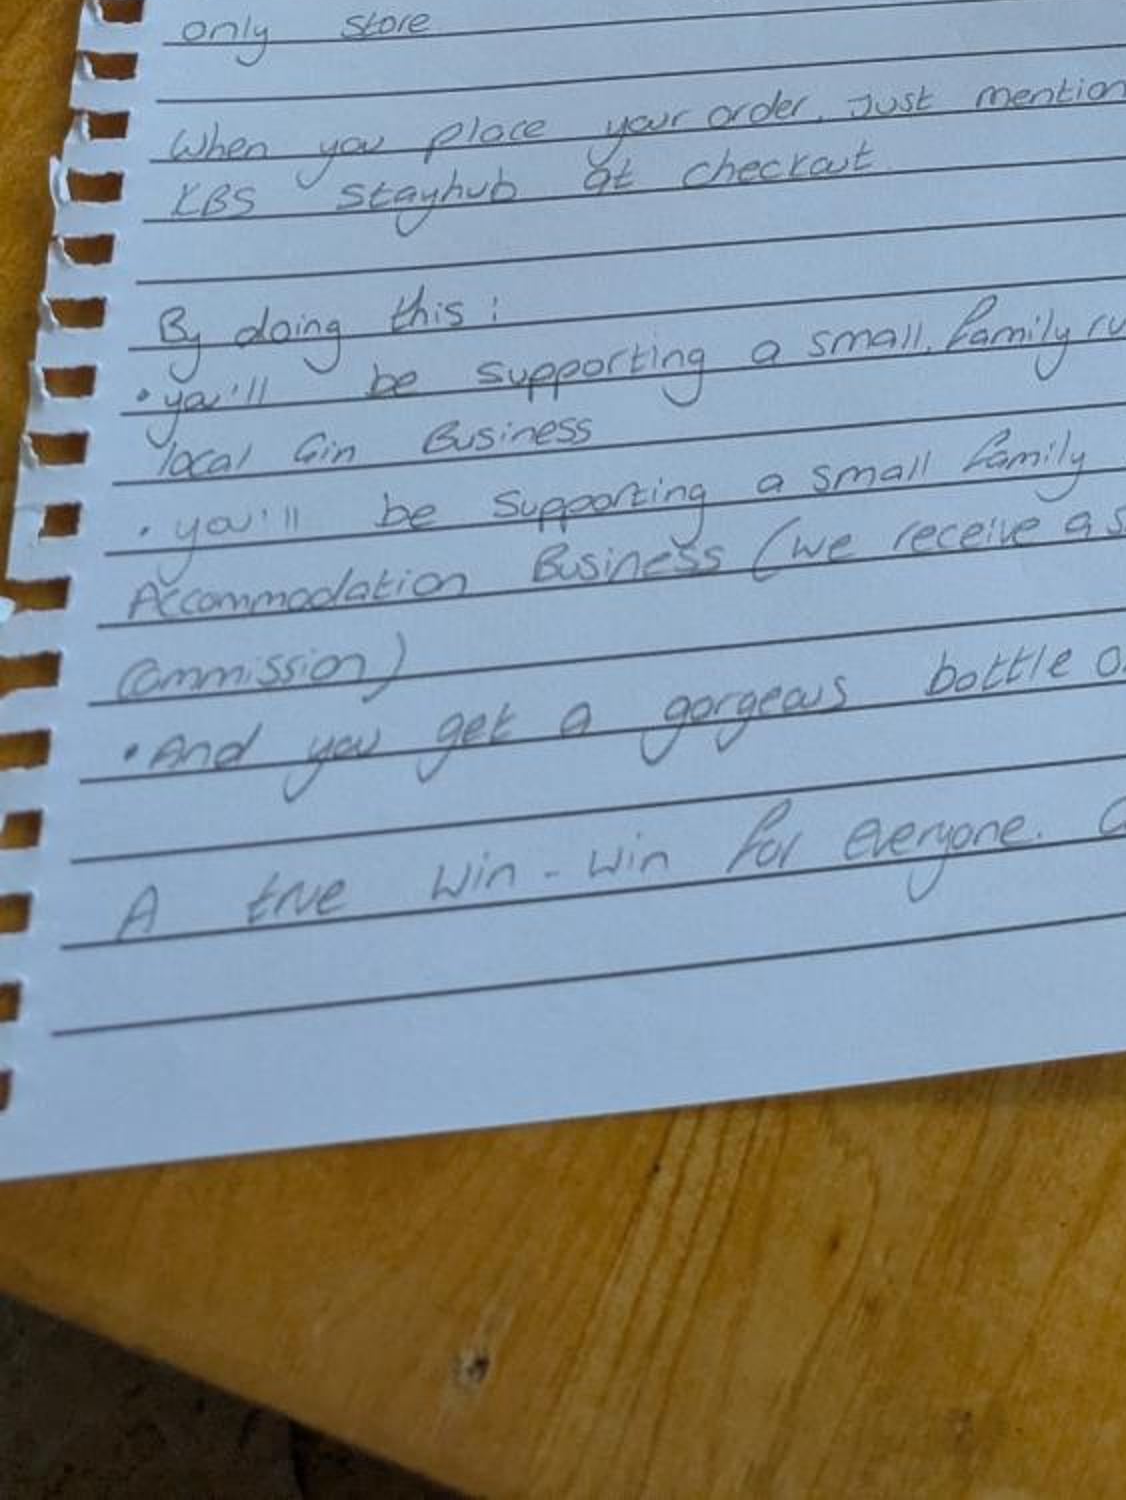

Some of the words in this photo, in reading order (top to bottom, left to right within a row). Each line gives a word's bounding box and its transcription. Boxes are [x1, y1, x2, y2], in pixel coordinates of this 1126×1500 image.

[181, 15, 270, 67] only
[168, 122, 270, 161] When
[295, 134, 385, 189] you
[424, 116, 545, 164] place
[587, 110, 685, 166] your
[583, 158, 635, 192] at
[683, 141, 873, 188] checkout
[159, 306, 201, 382] By
[234, 308, 342, 374] doing
[365, 363, 419, 401] be
[476, 343, 704, 408] supporting
[751, 341, 778, 366] a
[946, 294, 1070, 380] family
[158, 438, 254, 478] local
[294, 432, 356, 464] Gin
[423, 416, 593, 456] Business
[375, 494, 438, 531] be
[757, 474, 784, 495] a
[812, 451, 931, 493] small
[962, 427, 1087, 502] family
[532, 542, 725, 584] Business
[892, 516, 1040, 554] receive
[1064, 511, 1092, 537] a
[148, 722, 262, 770] And
[283, 728, 380, 803] you
[417, 702, 517, 783] get
[560, 701, 591, 734] a
[639, 674, 849, 766] gorgeous
[925, 649, 1073, 696] bottle
[116, 884, 159, 941] A
[247, 872, 347, 925] true
[726, 798, 803, 873] for
